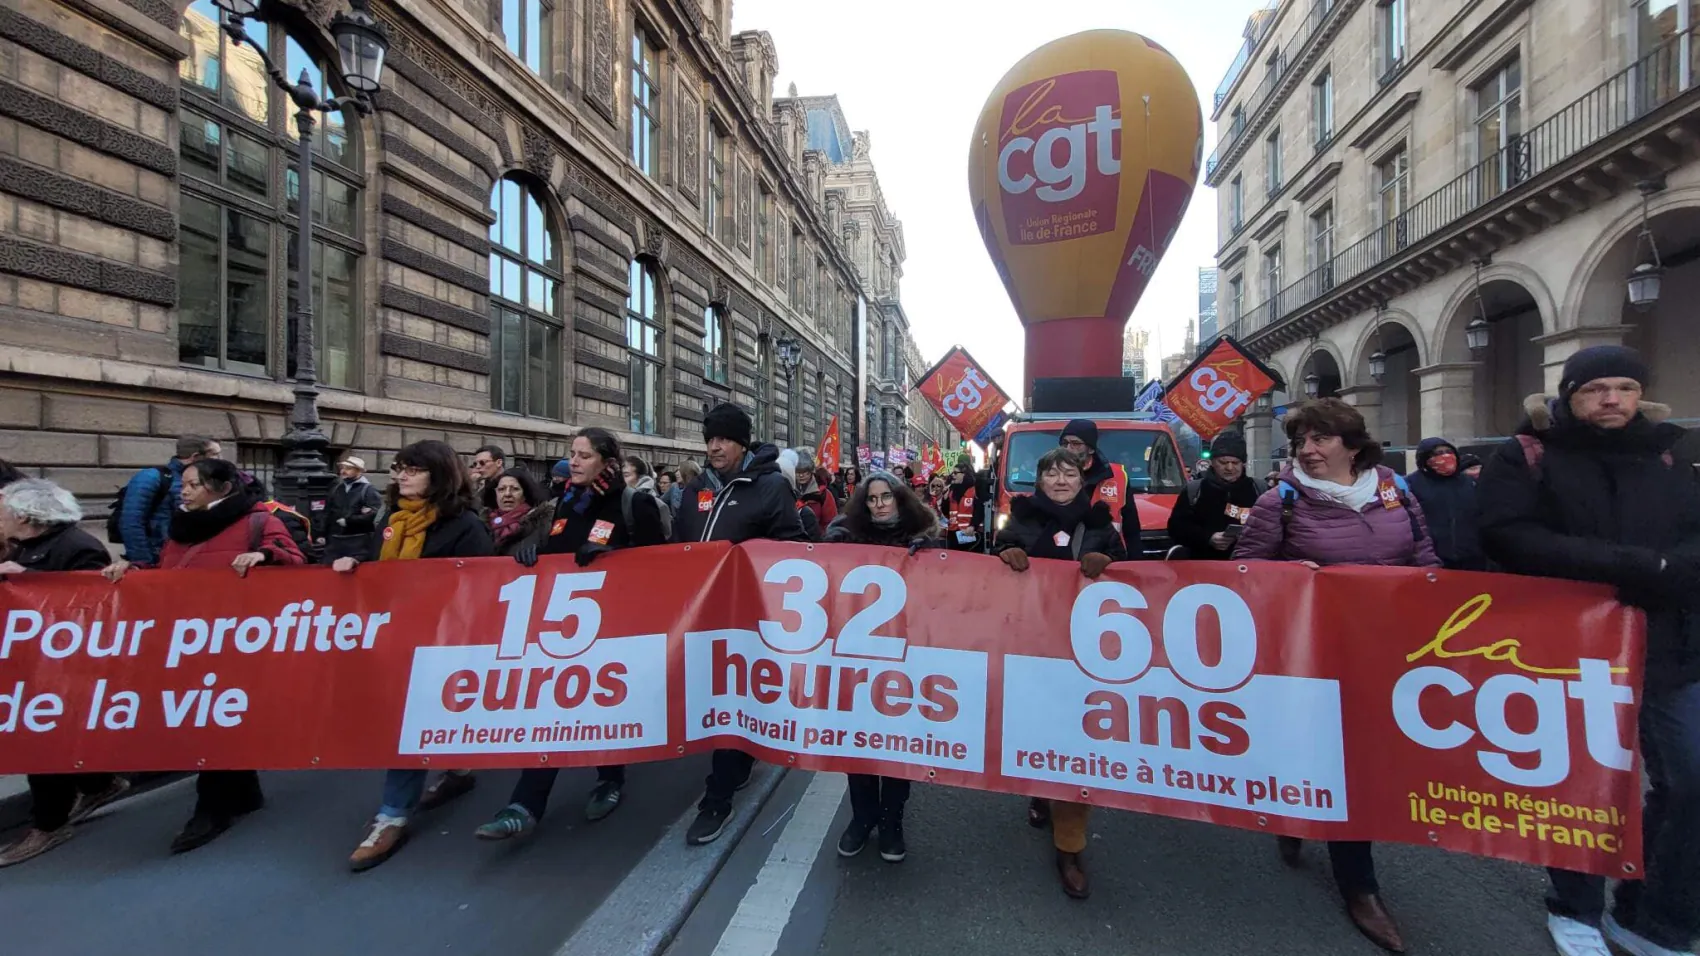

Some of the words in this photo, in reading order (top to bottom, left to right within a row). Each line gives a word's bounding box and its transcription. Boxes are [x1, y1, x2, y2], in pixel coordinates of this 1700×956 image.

[997, 104, 1122, 202] cgt
[942, 366, 990, 417] cgt
[1190, 366, 1252, 418] cgt
[1100, 485, 1118, 497] cgt
[0, 609, 155, 660] Pour
[165, 599, 391, 668] profiter
[498, 570, 607, 659] 15
[758, 558, 907, 661] 32
[1070, 581, 1257, 691] 60
[1406, 593, 1630, 674] la
[0, 681, 64, 733] de
[86, 679, 140, 730] la
[162, 672, 249, 728] vie
[441, 661, 629, 713] euros
[711, 638, 960, 723] heures
[419, 726, 456, 749] par
[462, 724, 526, 744] heure
[531, 720, 643, 742] minimum
[701, 708, 731, 729] de
[736, 708, 797, 742] travail
[803, 727, 847, 749] par
[854, 730, 968, 760] semaine
[1081, 689, 1251, 757] ans
[1391, 657, 1634, 788] cgt
[1016, 748, 1129, 781] retraite
[1136, 757, 1154, 785] à
[1163, 764, 1237, 796] taux
[1245, 775, 1333, 809] plein
[1427, 781, 1498, 807] Union
[1408, 792, 1623, 853] Île-de-Franc
